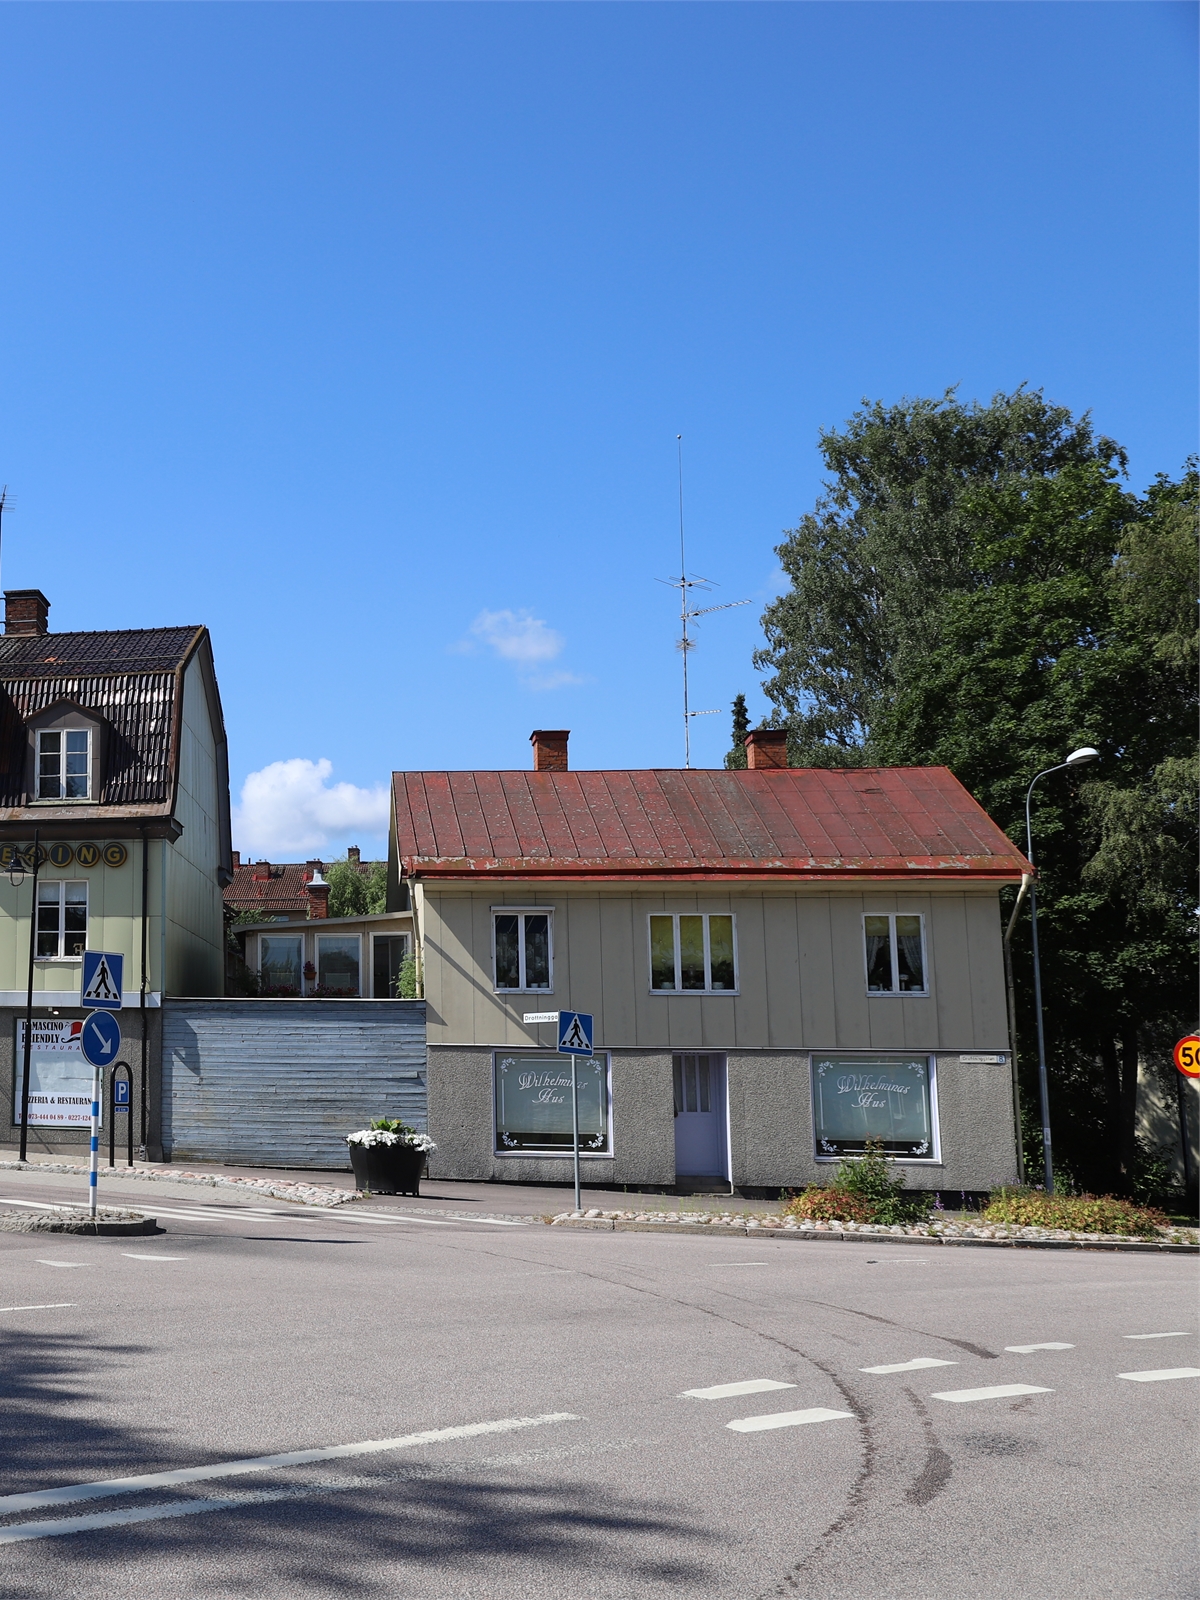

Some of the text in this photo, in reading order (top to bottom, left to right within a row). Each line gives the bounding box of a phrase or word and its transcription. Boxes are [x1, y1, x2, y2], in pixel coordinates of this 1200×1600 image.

[21, 1021, 64, 1031] DMASCINO
[524, 1014, 558, 1022] Drottningga
[21, 1033, 60, 1044] FIENDLY
[518, 1071, 588, 1090] Wilhelmias
[837, 1074, 911, 1094] Wilhelminas
[118, 1082, 127, 1102] P
[531, 1088, 565, 1104] Hus
[851, 1092, 886, 1108] Hus
[21, 1096, 49, 1104] ZZERIA
[57, 1096, 92, 1105] RESTAURAN
